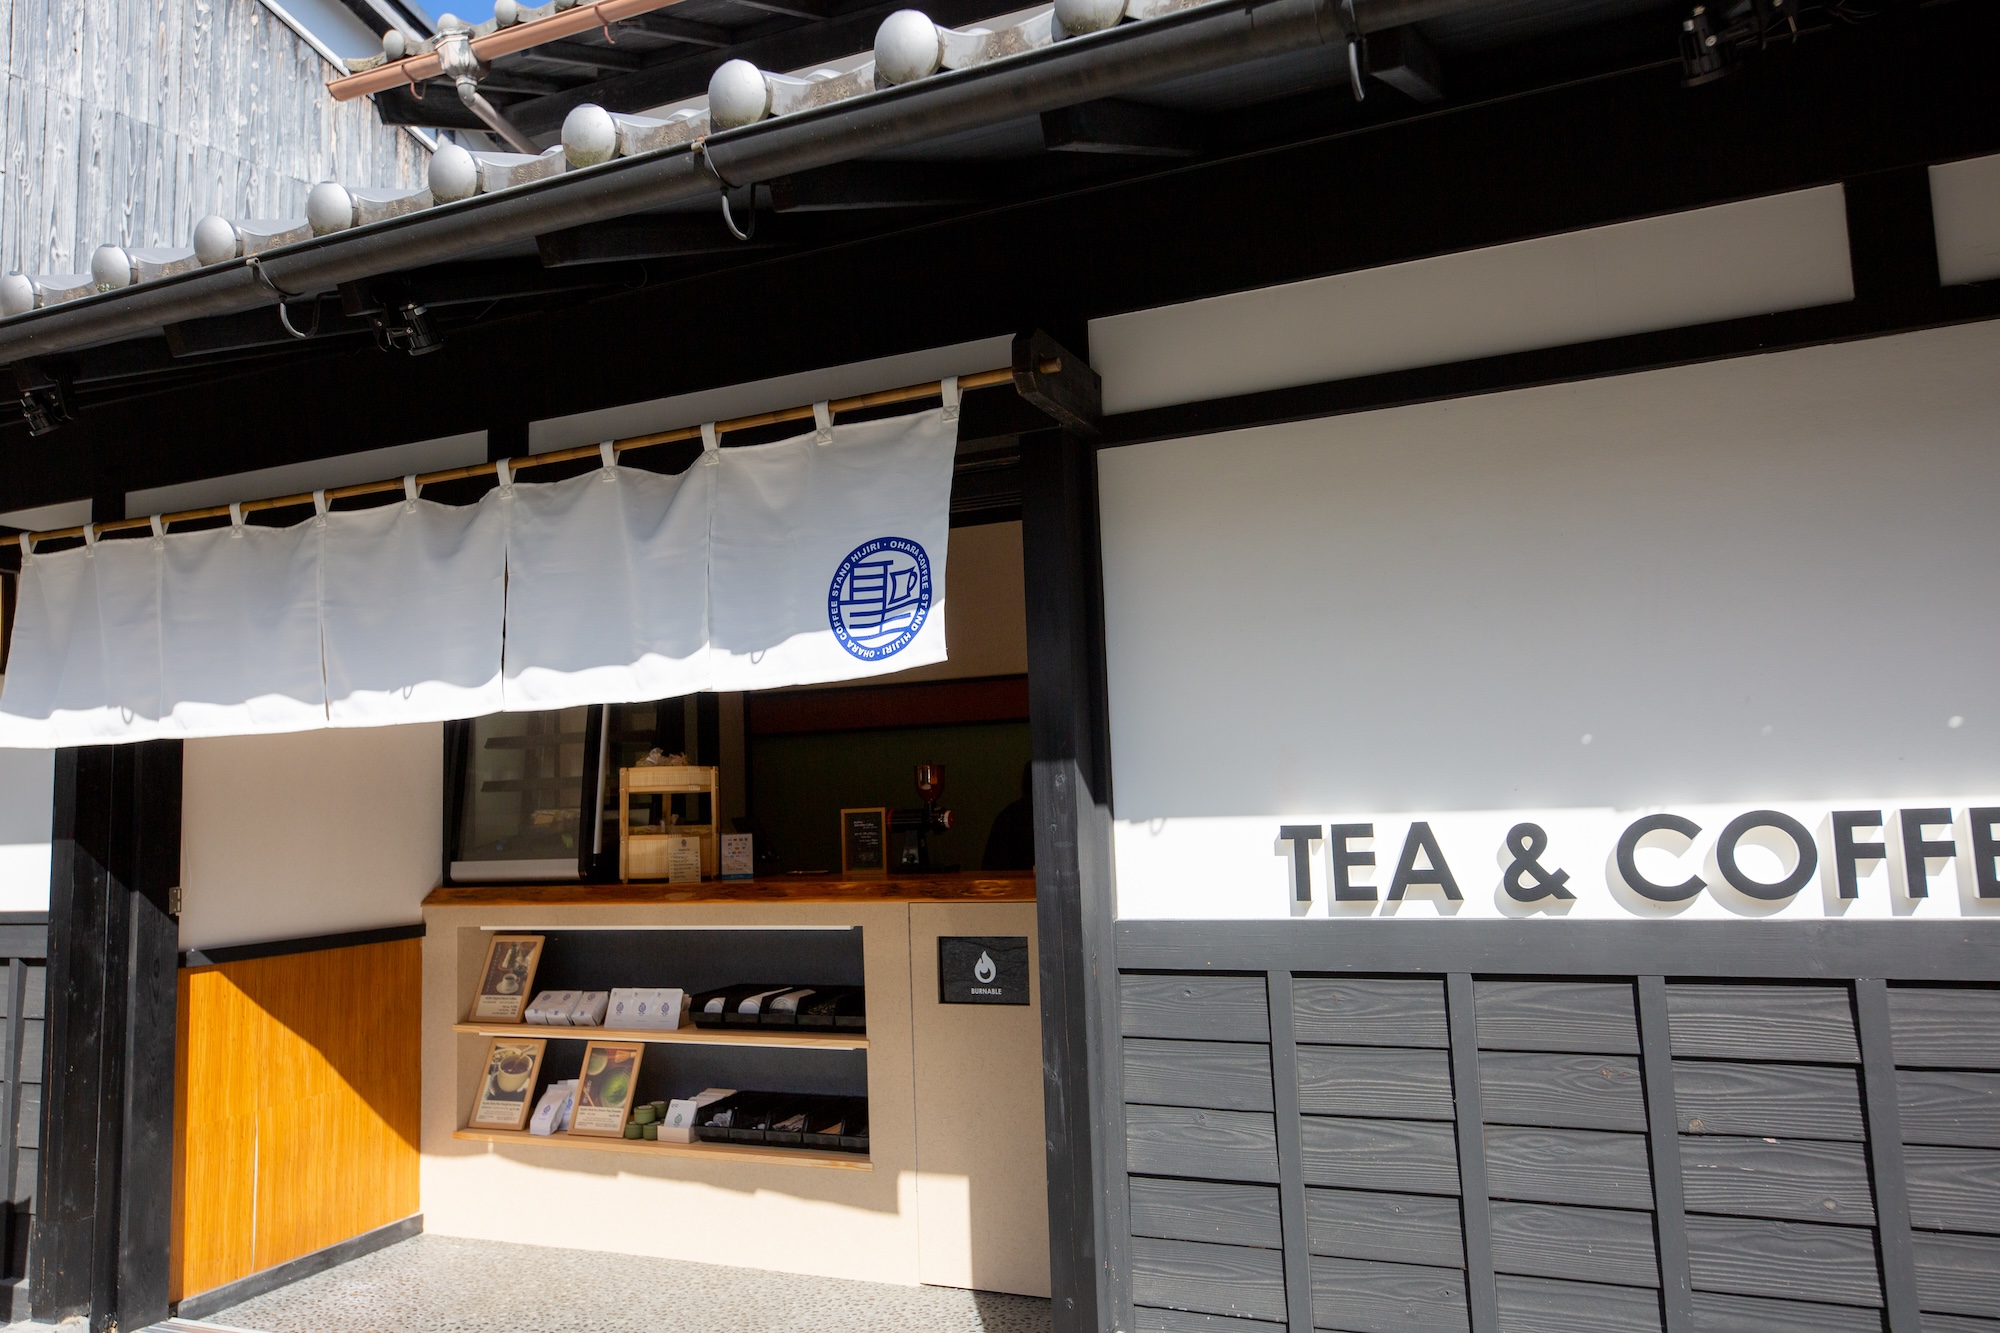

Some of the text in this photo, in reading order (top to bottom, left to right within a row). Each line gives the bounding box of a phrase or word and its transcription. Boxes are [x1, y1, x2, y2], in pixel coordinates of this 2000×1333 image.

[831, 541, 881, 658] OHARA COFFEE STAND HIJIRI
[882, 540, 929, 656] OHARA COFFEE STAND HIJIRI
[1280, 822, 1464, 902] TEA
[1503, 822, 1577, 902] &
[970, 987, 1002, 995] BURNABLE
